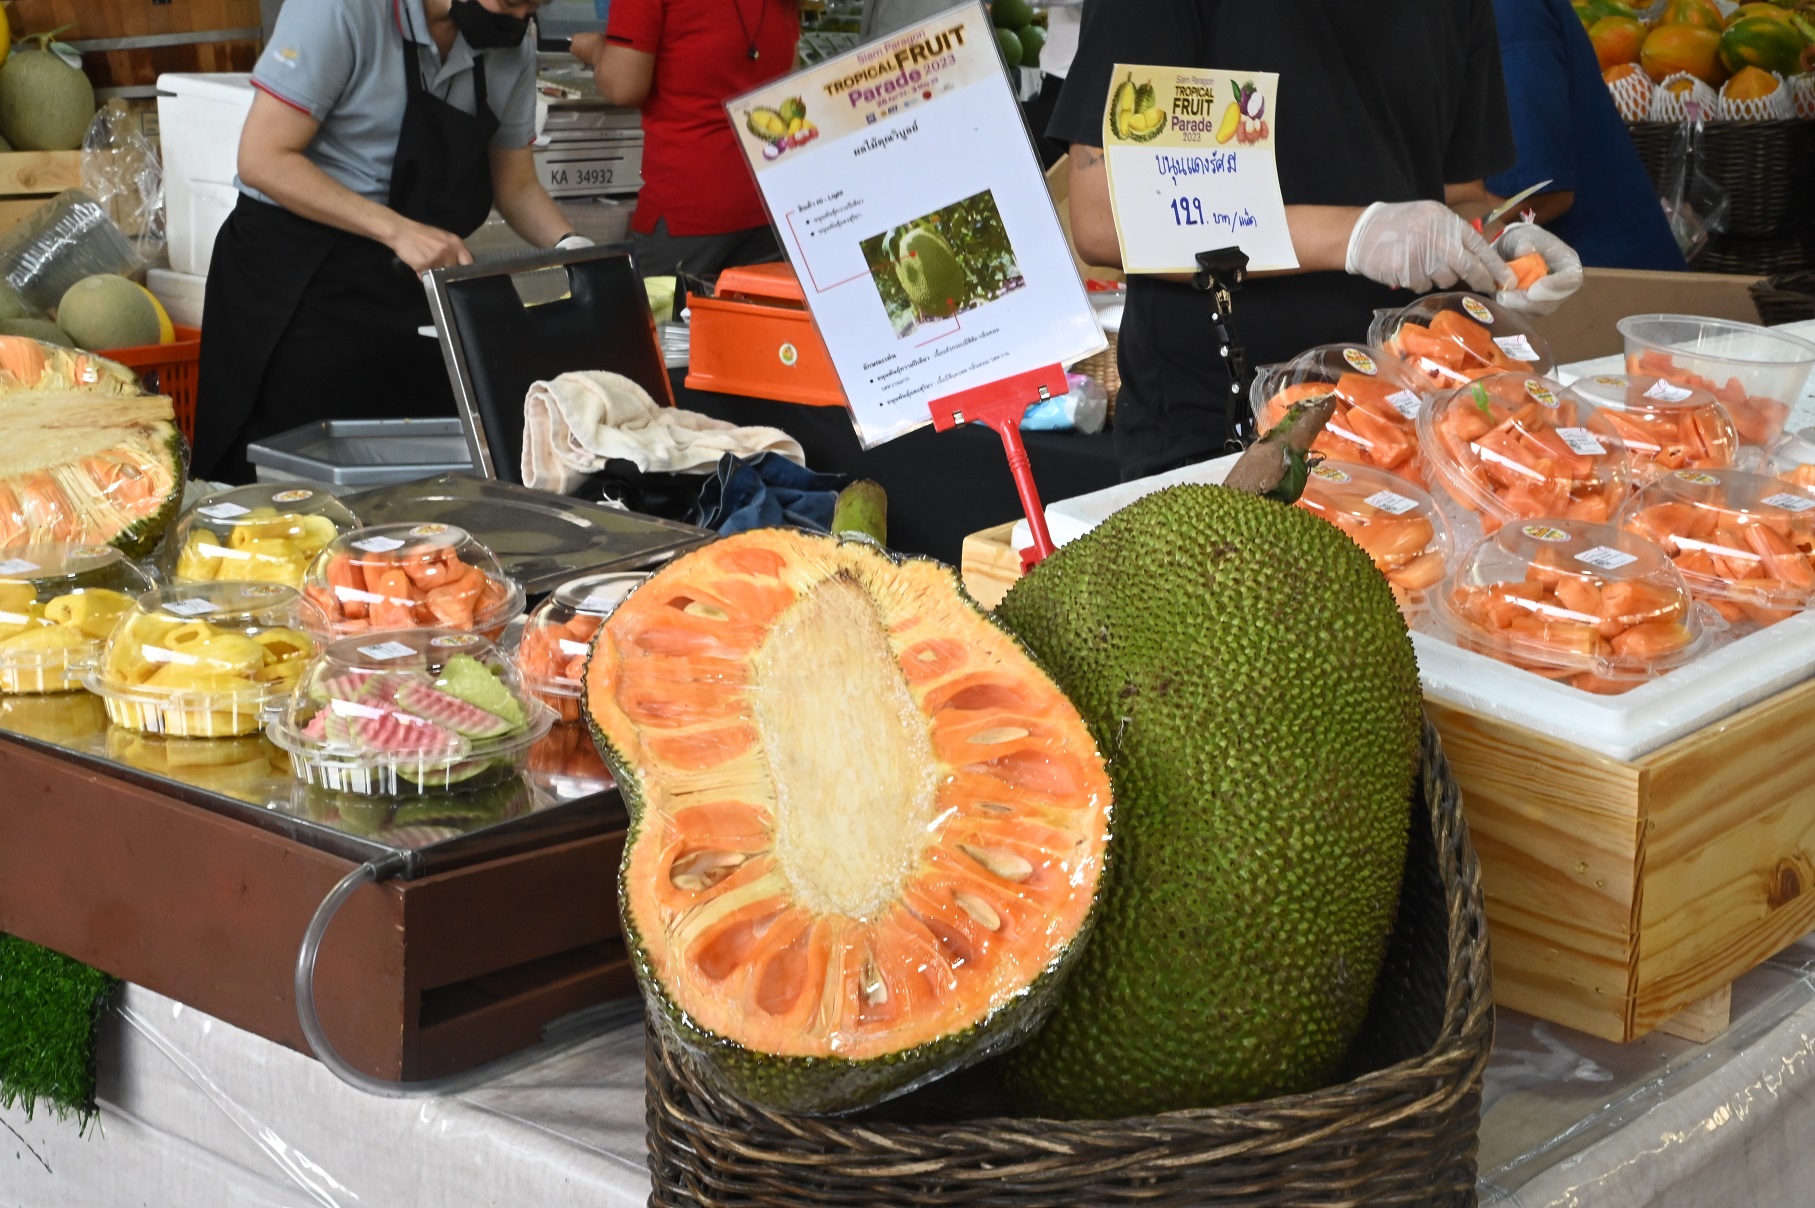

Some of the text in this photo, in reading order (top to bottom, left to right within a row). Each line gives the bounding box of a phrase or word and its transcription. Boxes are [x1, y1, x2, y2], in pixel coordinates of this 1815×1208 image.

[857, 30, 926, 65] Siam Paragon
[824, 24, 964, 96] TROPICAL FRUIT
[848, 53, 956, 108] Parade 2023
[1176, 75, 1215, 86] Siam Paragon
[1175, 85, 1214, 98] TROPICAL
[1172, 97, 1213, 116] FRUIT
[1171, 115, 1212, 133] Parade
[1182, 132, 1202, 142] 2023
[551, 168, 613, 185] KA 34932
